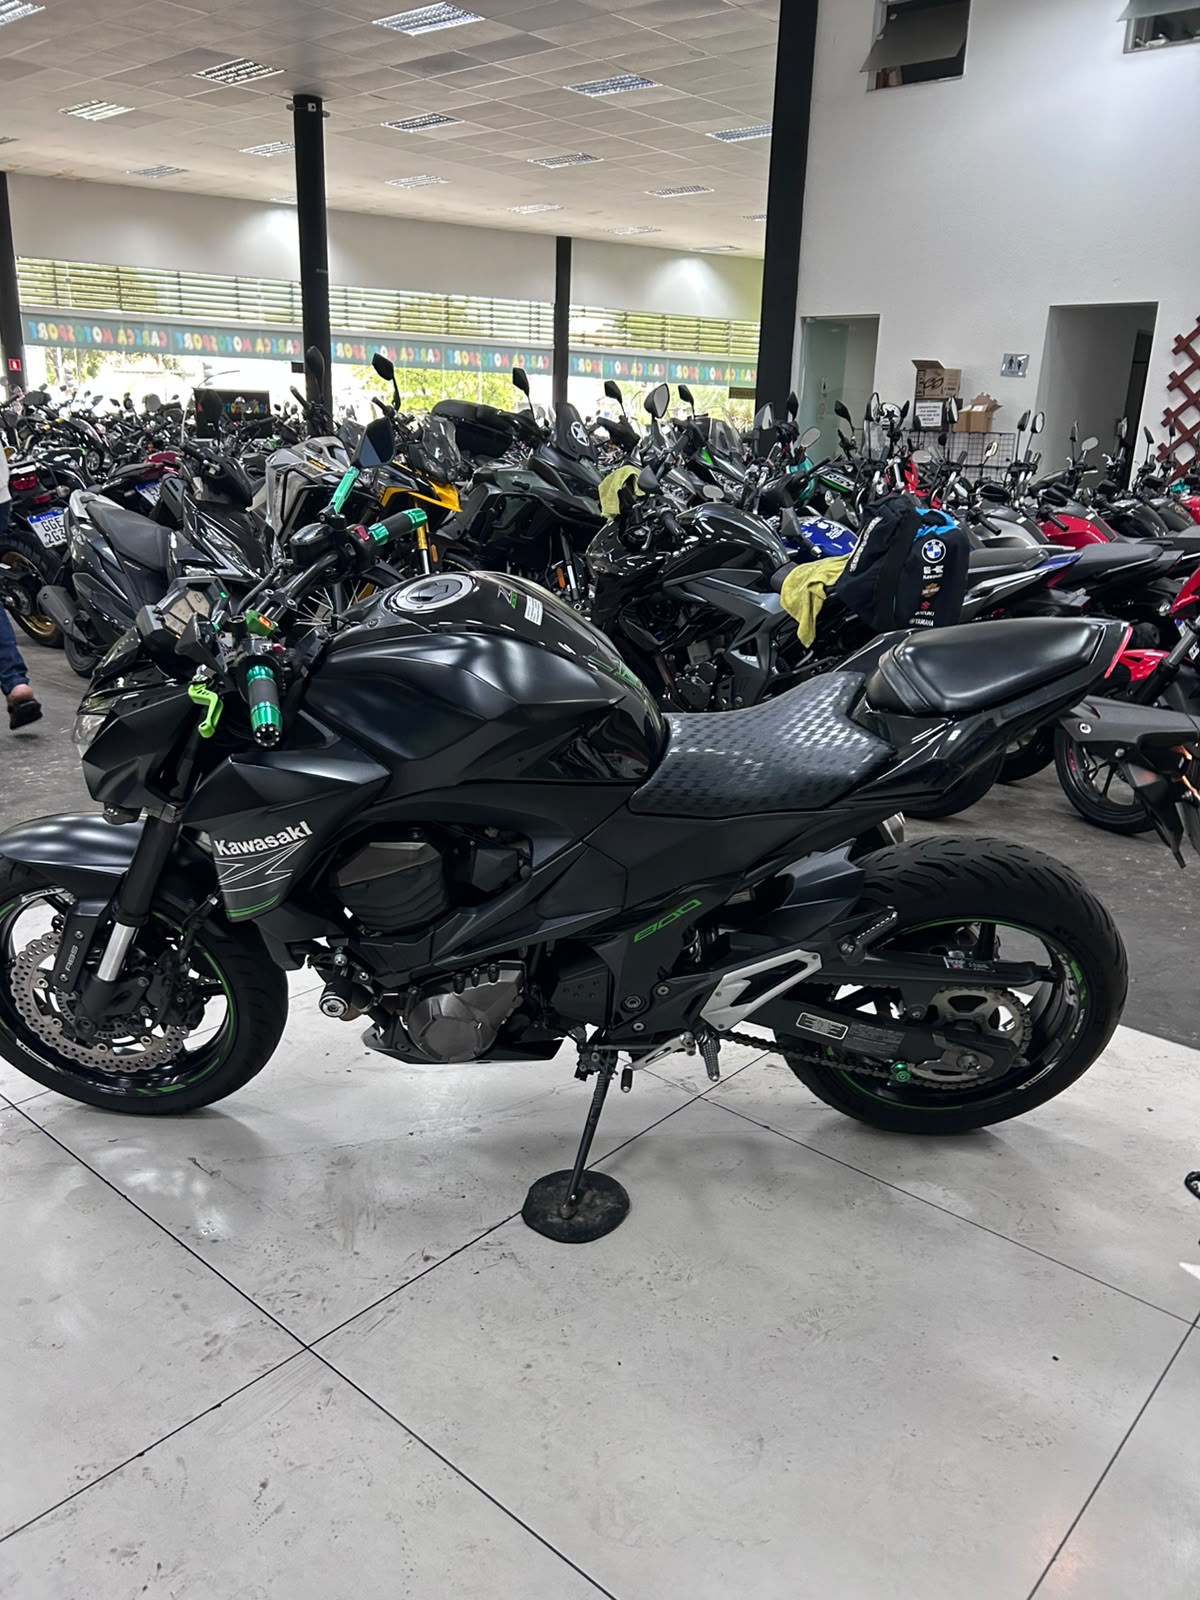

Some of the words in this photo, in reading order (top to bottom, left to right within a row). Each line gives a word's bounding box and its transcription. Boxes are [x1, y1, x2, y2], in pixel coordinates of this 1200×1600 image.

[41, 517, 64, 532] GGE
[214, 820, 313, 857] Kawasaki
[633, 898, 703, 943] 800
[64, 944, 79, 972] ABS
